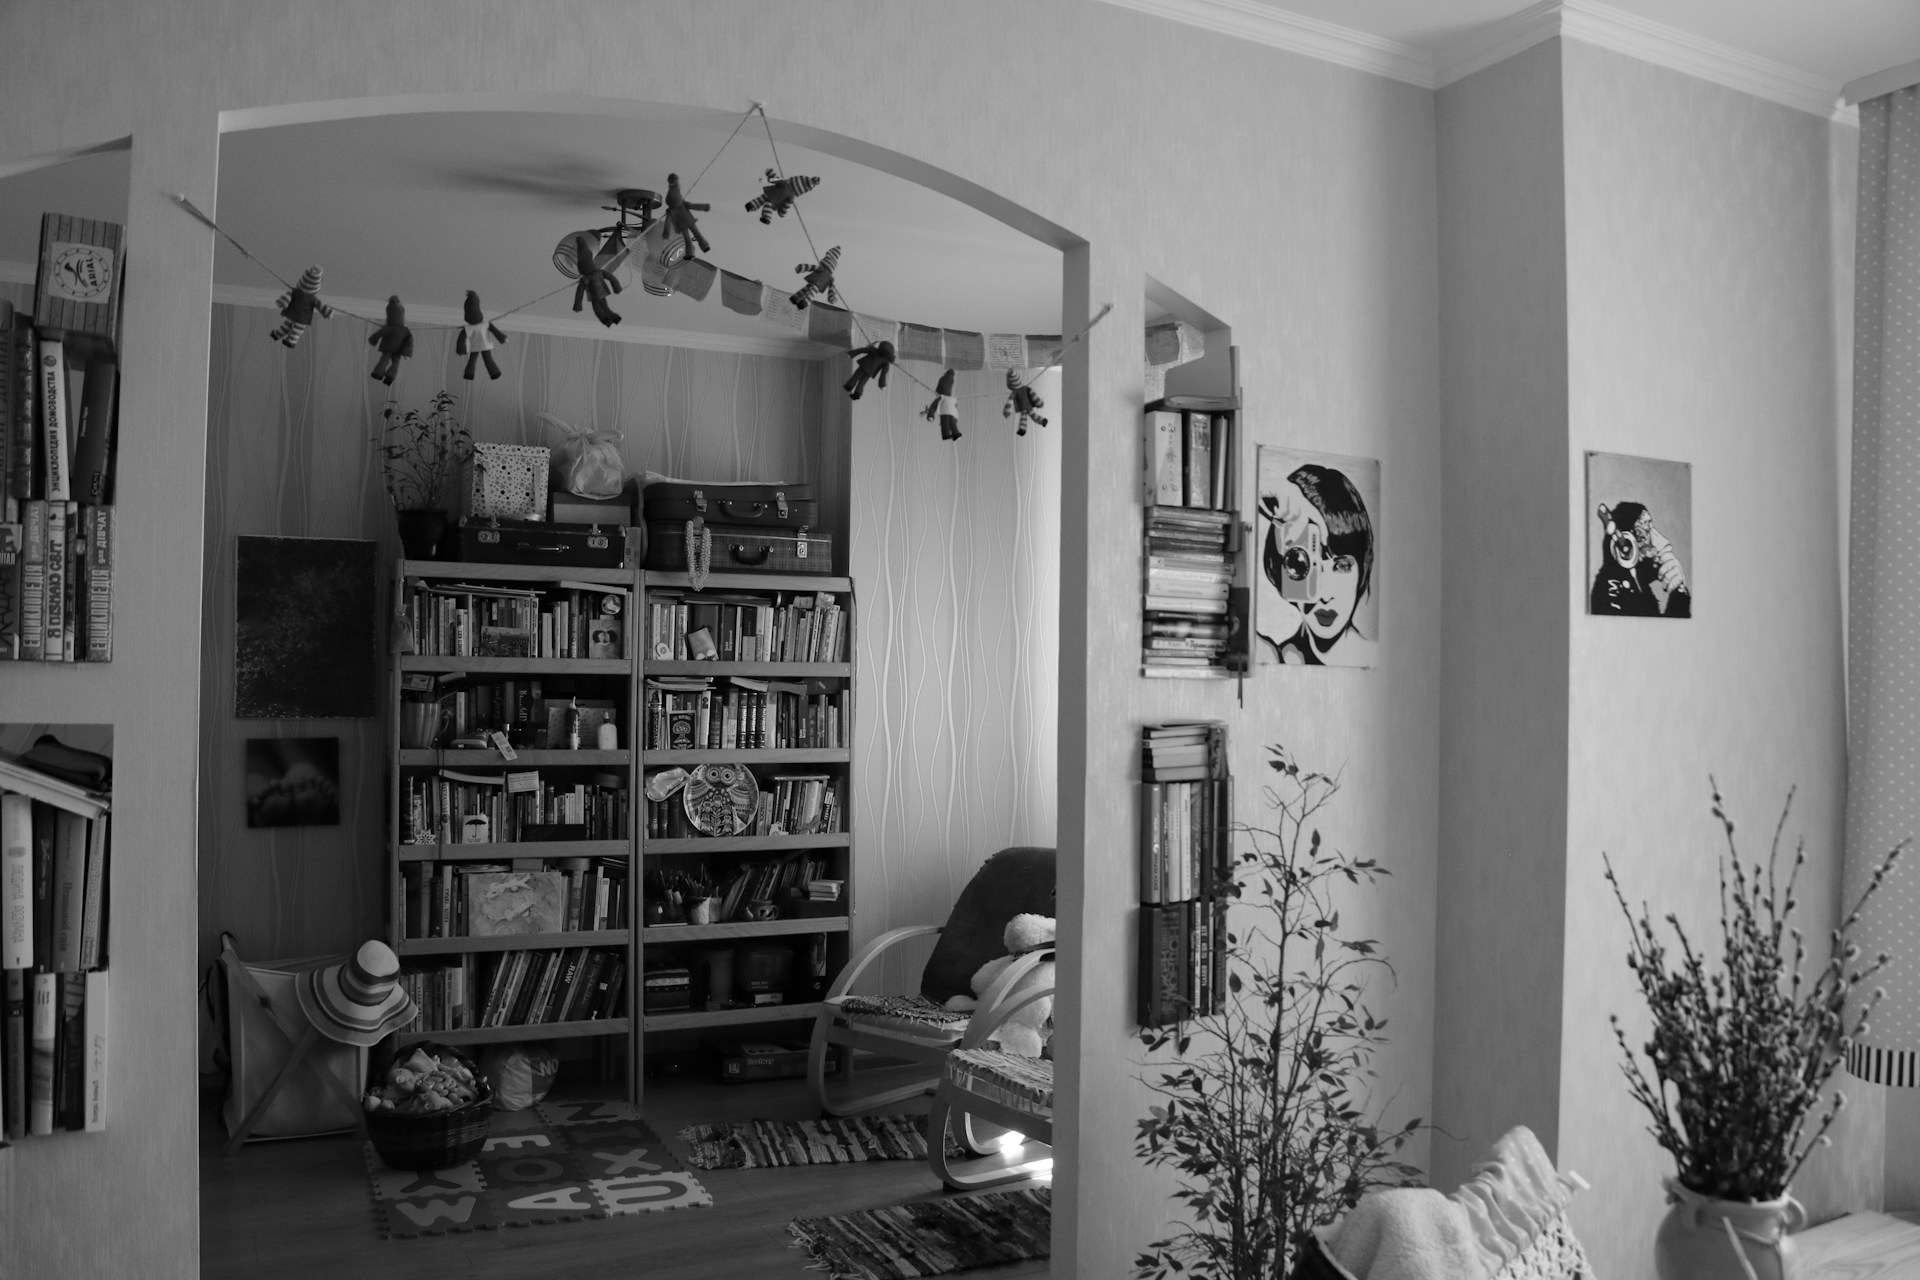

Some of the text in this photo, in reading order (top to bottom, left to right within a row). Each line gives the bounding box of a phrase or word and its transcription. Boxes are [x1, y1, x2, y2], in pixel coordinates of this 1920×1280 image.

[86, 257, 97, 287] ARIAL
[46, 371, 60, 492] ЭНЦИКЛОПЕДИЯ ДОМОВОДСТВА
[29, 505, 40, 544] ДІВЧАТ
[97, 510, 107, 548] ДІВЧАТ
[23, 564, 43, 647] ЕНЦИКЛОПЕДІЯ
[48, 540, 62, 638] Я ПІЗНАЮ СВІТ
[90, 569, 109, 651] ЕНЦИКЛОПЕДІЯ
[495, 1158, 563, 1183] O
[591, 1148, 663, 1175] X
[507, 1187, 592, 1210] A
[606, 1180, 688, 1205] U
